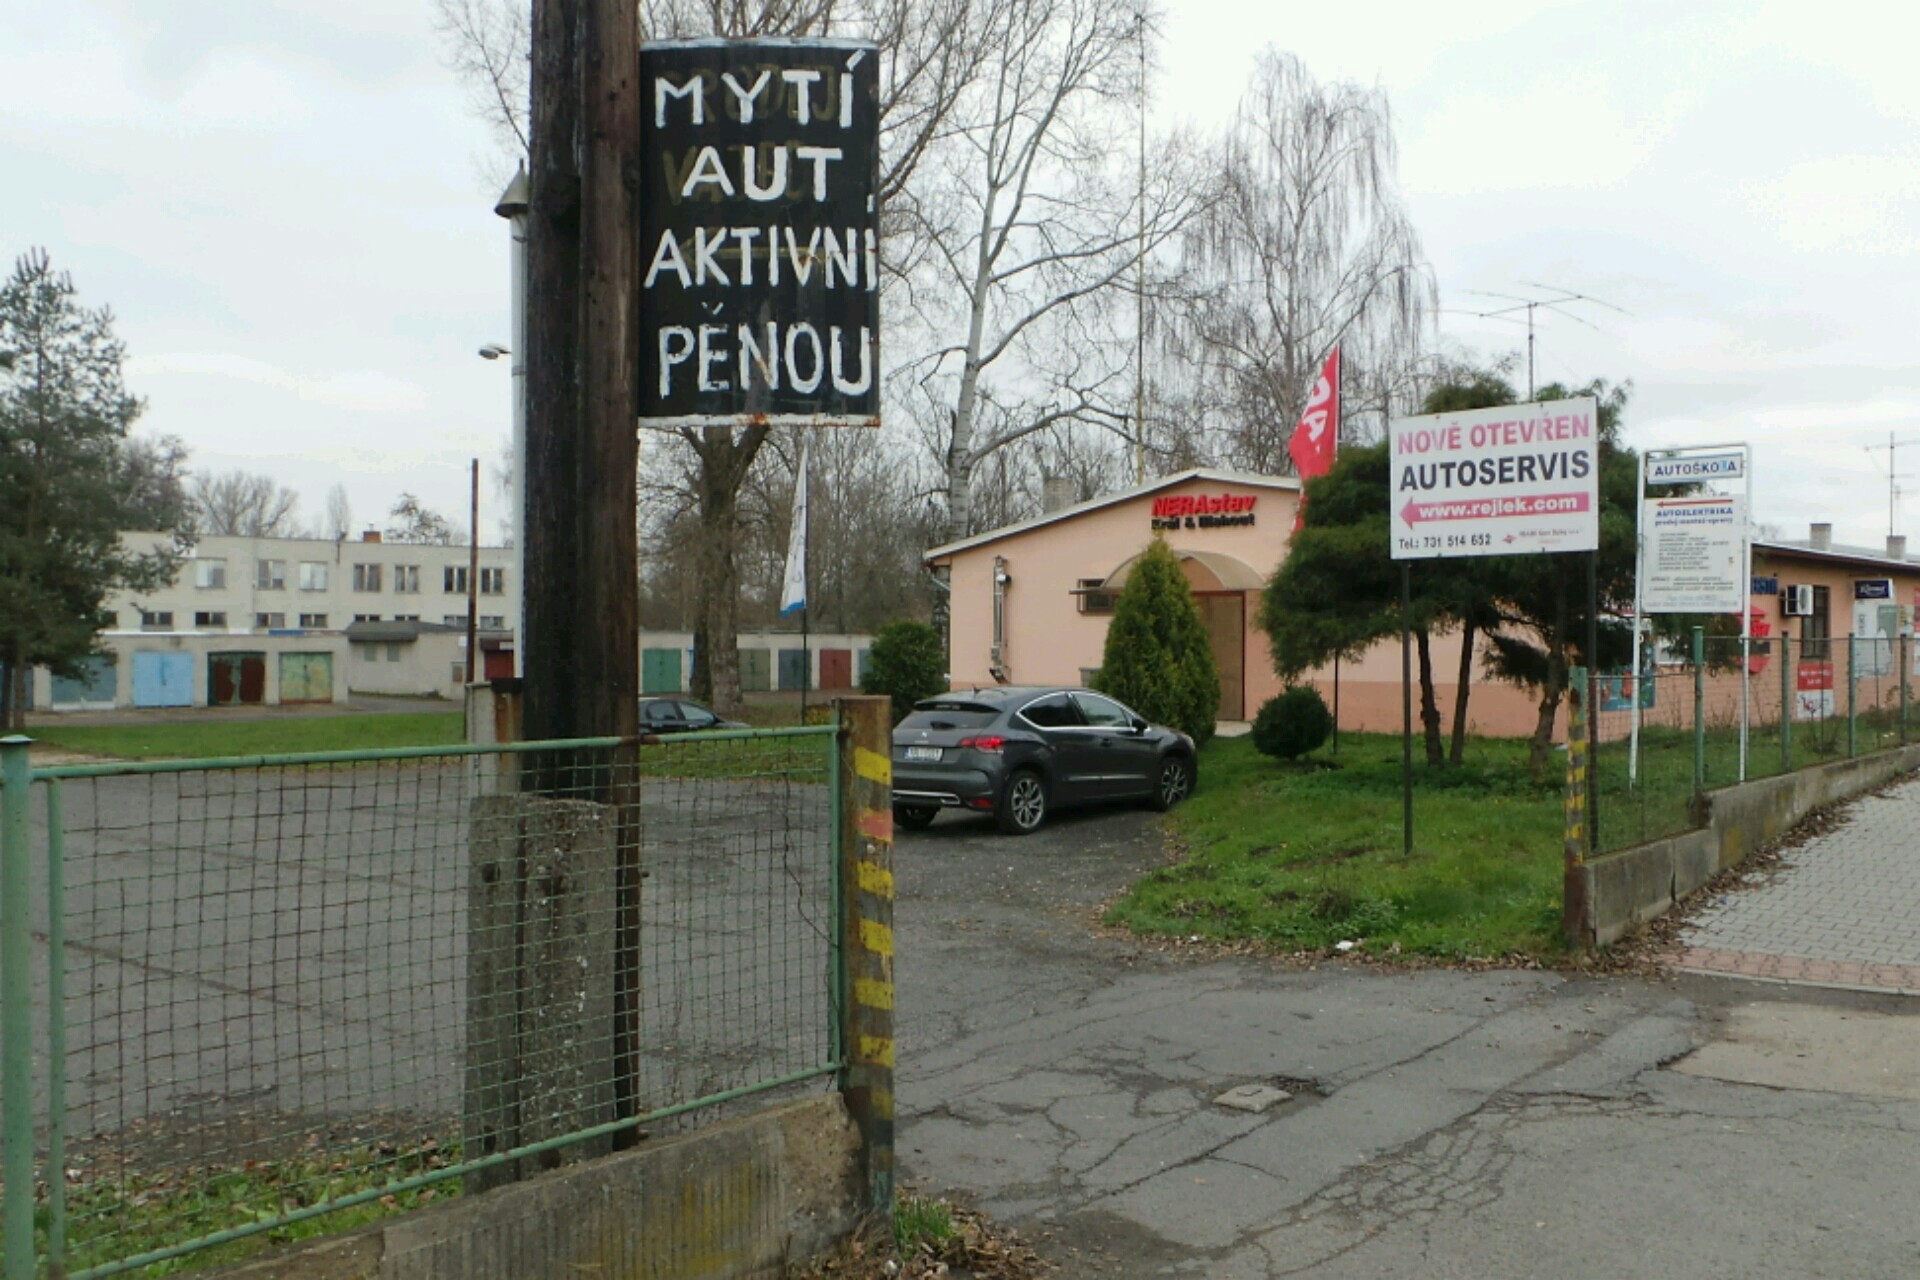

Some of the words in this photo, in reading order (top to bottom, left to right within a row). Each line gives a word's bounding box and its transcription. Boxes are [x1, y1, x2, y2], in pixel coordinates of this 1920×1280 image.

[654, 49, 867, 129] MYTÍ
[681, 145, 844, 203] AUT
[644, 193, 879, 293] AKTIVNÍ
[658, 301, 872, 399] PĚNOU
[1398, 421, 1461, 454] NOVĚ
[1470, 412, 1588, 447] OTEVŘEN
[1400, 450, 1590, 491] AUTOSERVIS
[1419, 496, 1577, 519] www.rejlek.com
[1423, 535, 1442, 549] 731
[1447, 534, 1466, 548] 514
